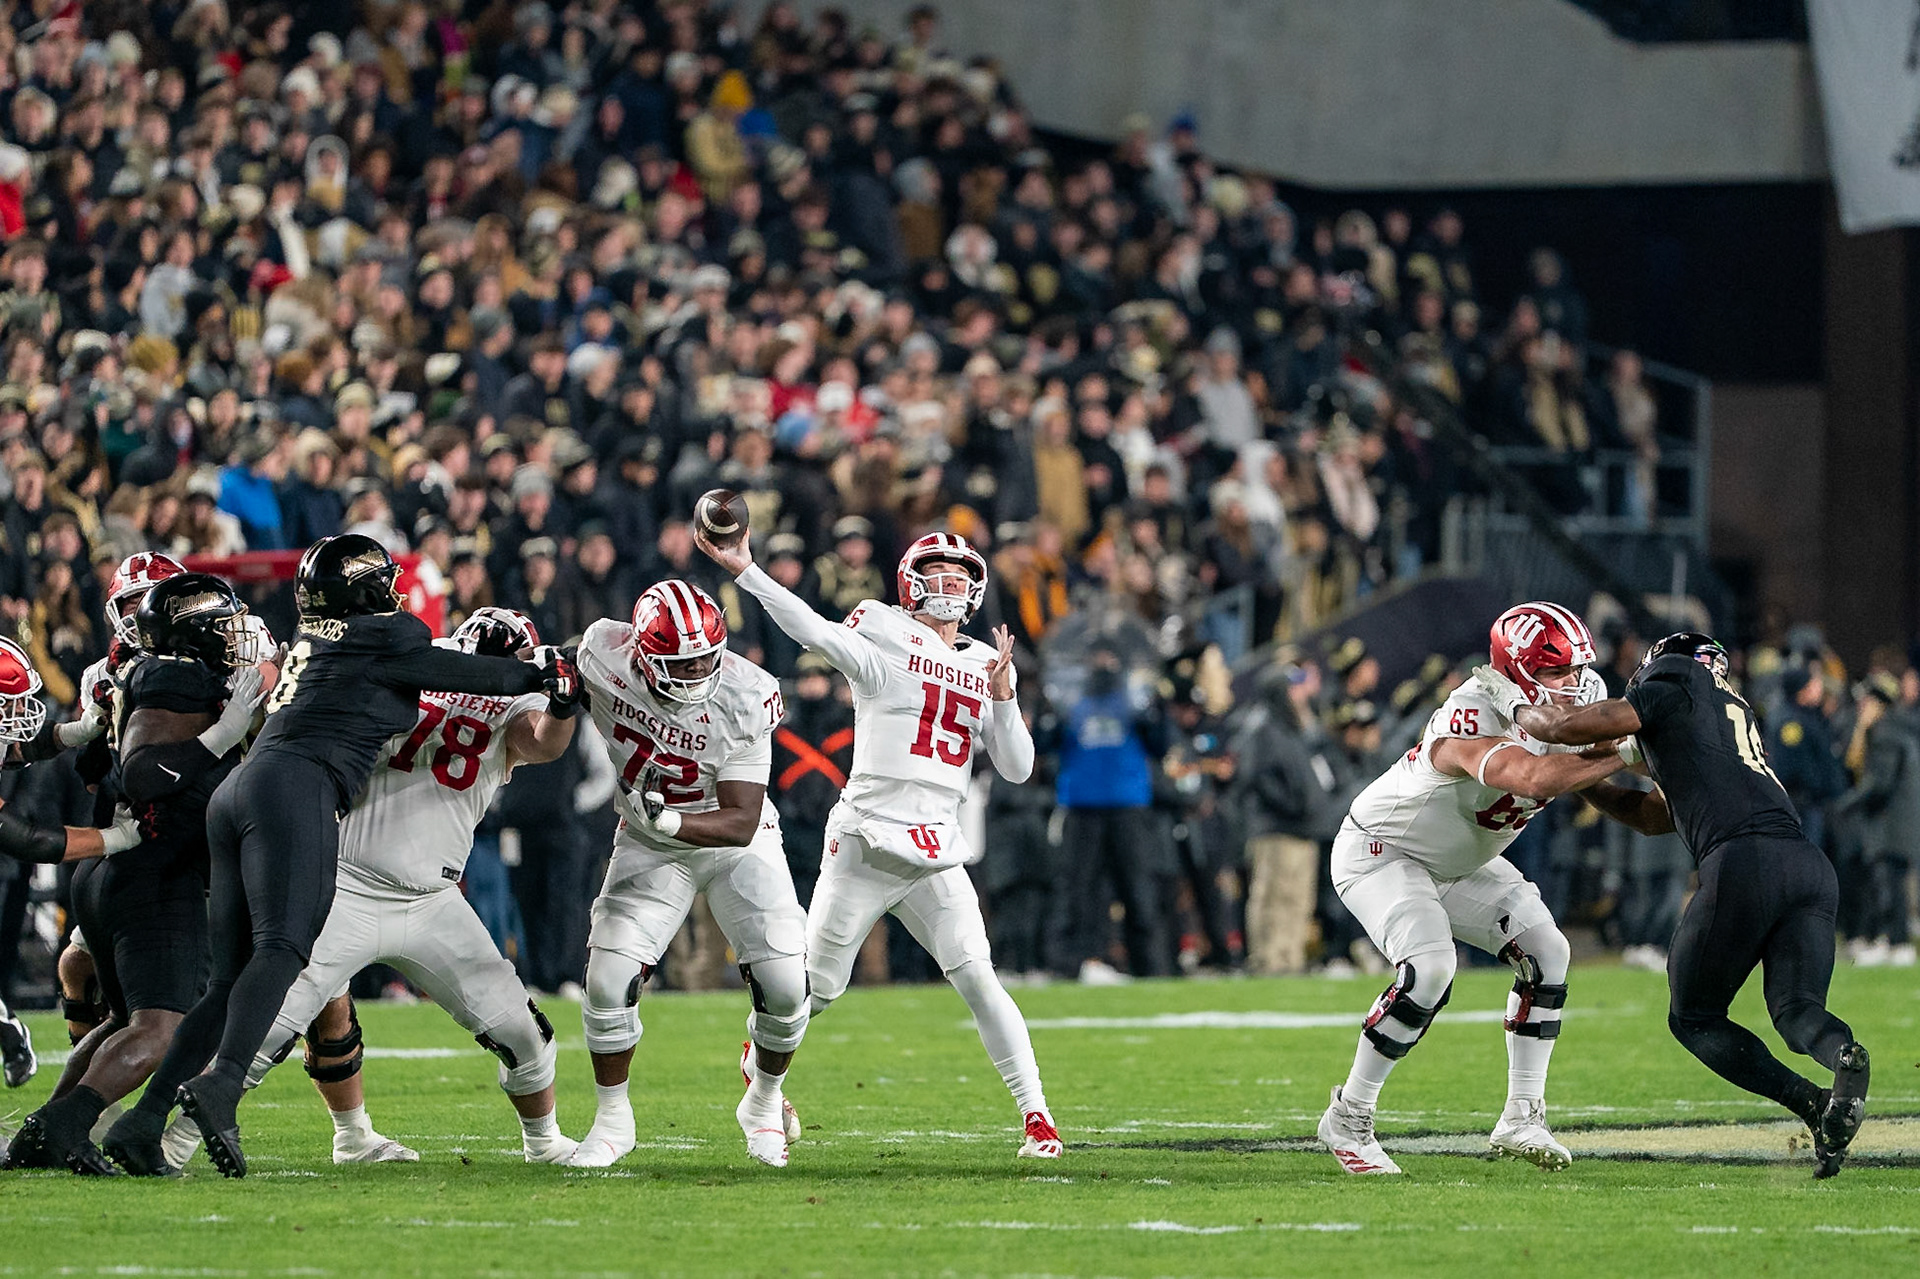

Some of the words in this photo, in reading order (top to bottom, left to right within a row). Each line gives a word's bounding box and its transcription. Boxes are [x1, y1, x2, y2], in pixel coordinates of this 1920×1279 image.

[163, 590, 220, 616] Purdue
[907, 654, 994, 699] HOOSIERS
[611, 696, 708, 752] HOOSIERS
[763, 691, 784, 725] 72
[910, 681, 982, 768] 15
[1450, 708, 1480, 736] 65
[387, 700, 493, 792] 78
[612, 722, 705, 806] 72
